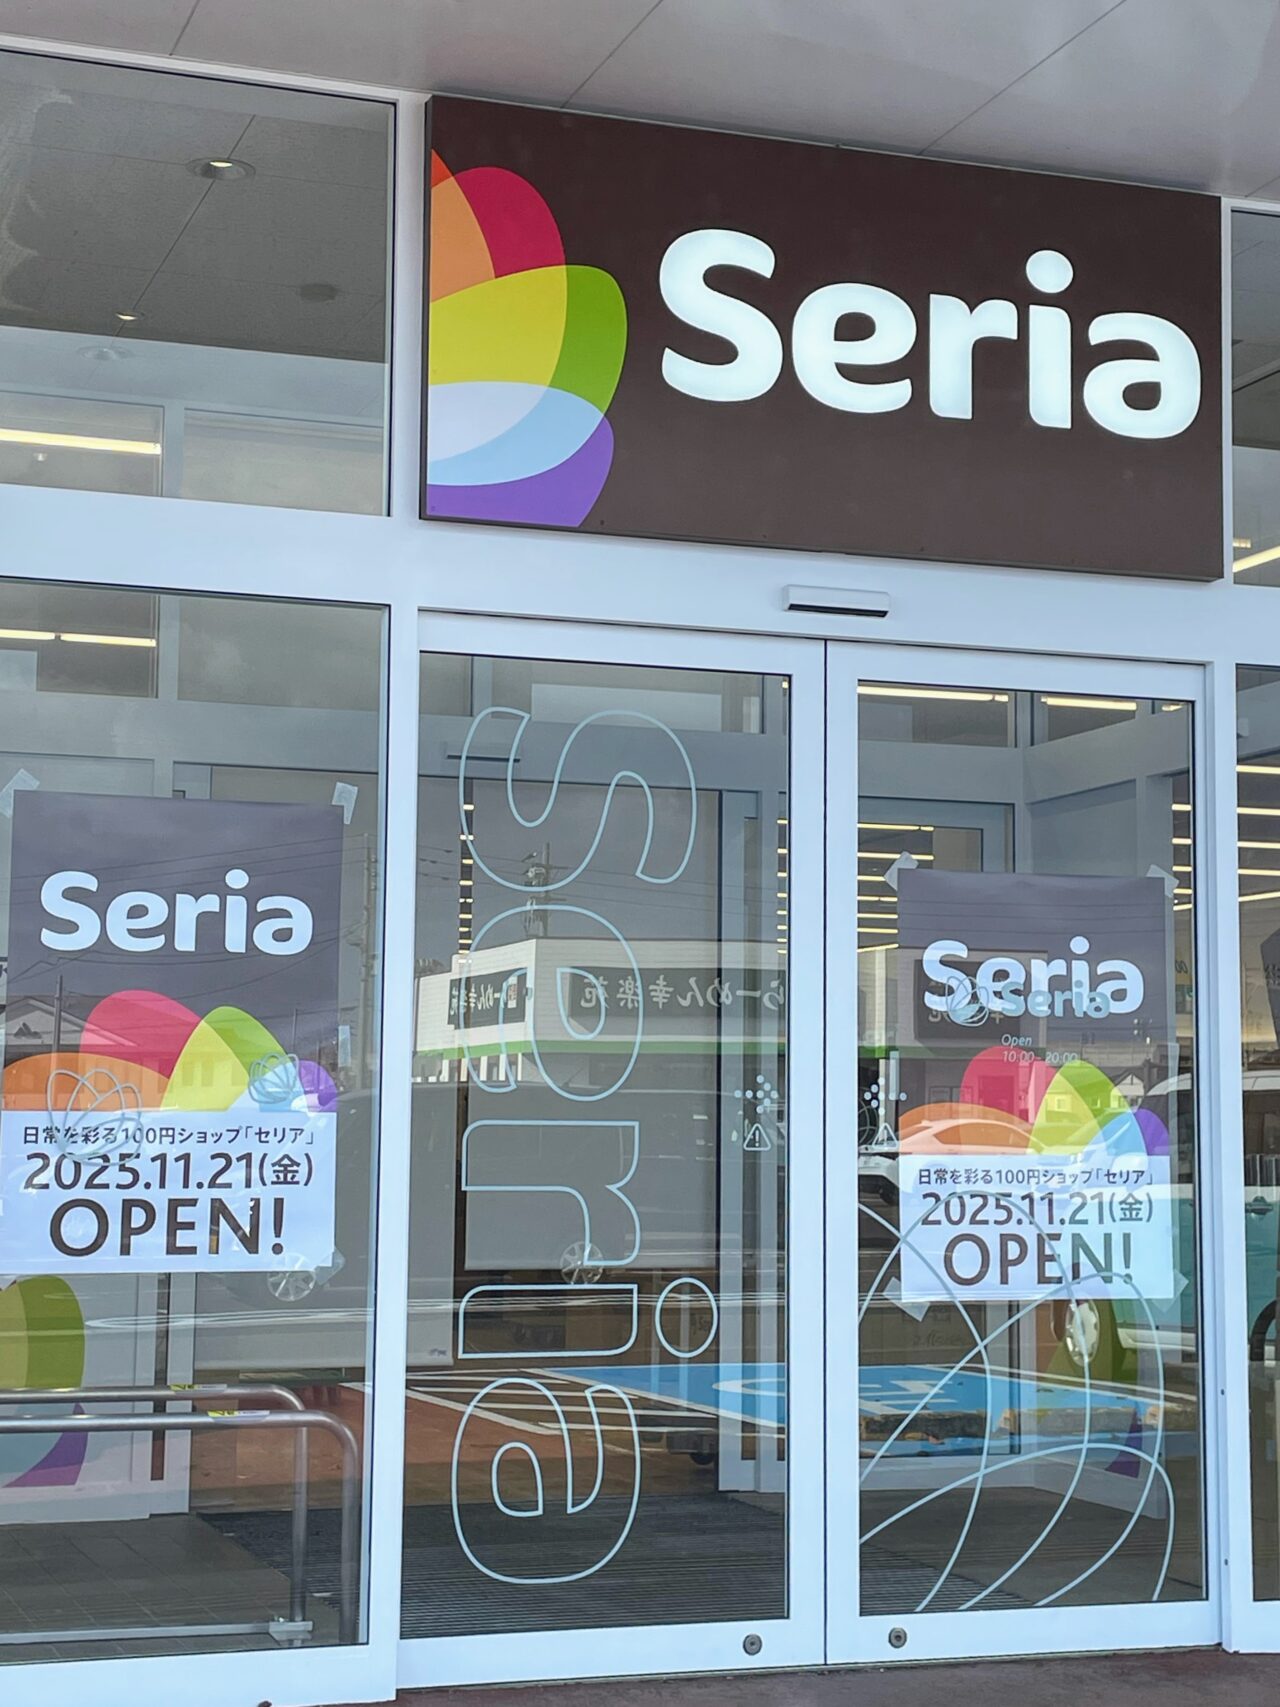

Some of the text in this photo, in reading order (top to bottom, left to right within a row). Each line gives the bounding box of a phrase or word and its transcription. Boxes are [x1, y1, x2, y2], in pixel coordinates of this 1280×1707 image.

[659, 228, 1201, 439] Seria
[40, 869, 313, 955] Seria
[922, 935, 1144, 1014] Seria
[1000, 979, 1110, 1018] Seria
[1001, 1034, 1032, 1048] Open
[1002, 1051, 1034, 1063] 10:00
[1045, 1052, 1078, 1064] 20:00
[450, 707, 719, 1585] Seria
[24, 1151, 313, 1190] 2025.11.21(金)
[918, 1168, 1152, 1186] 日常を彩る100円ショップ「セリア」
[50, 1197, 285, 1257] OPEN!
[921, 1191, 1153, 1226] 2025.11.21(金)
[944, 1231, 1131, 1286] OPEN!
